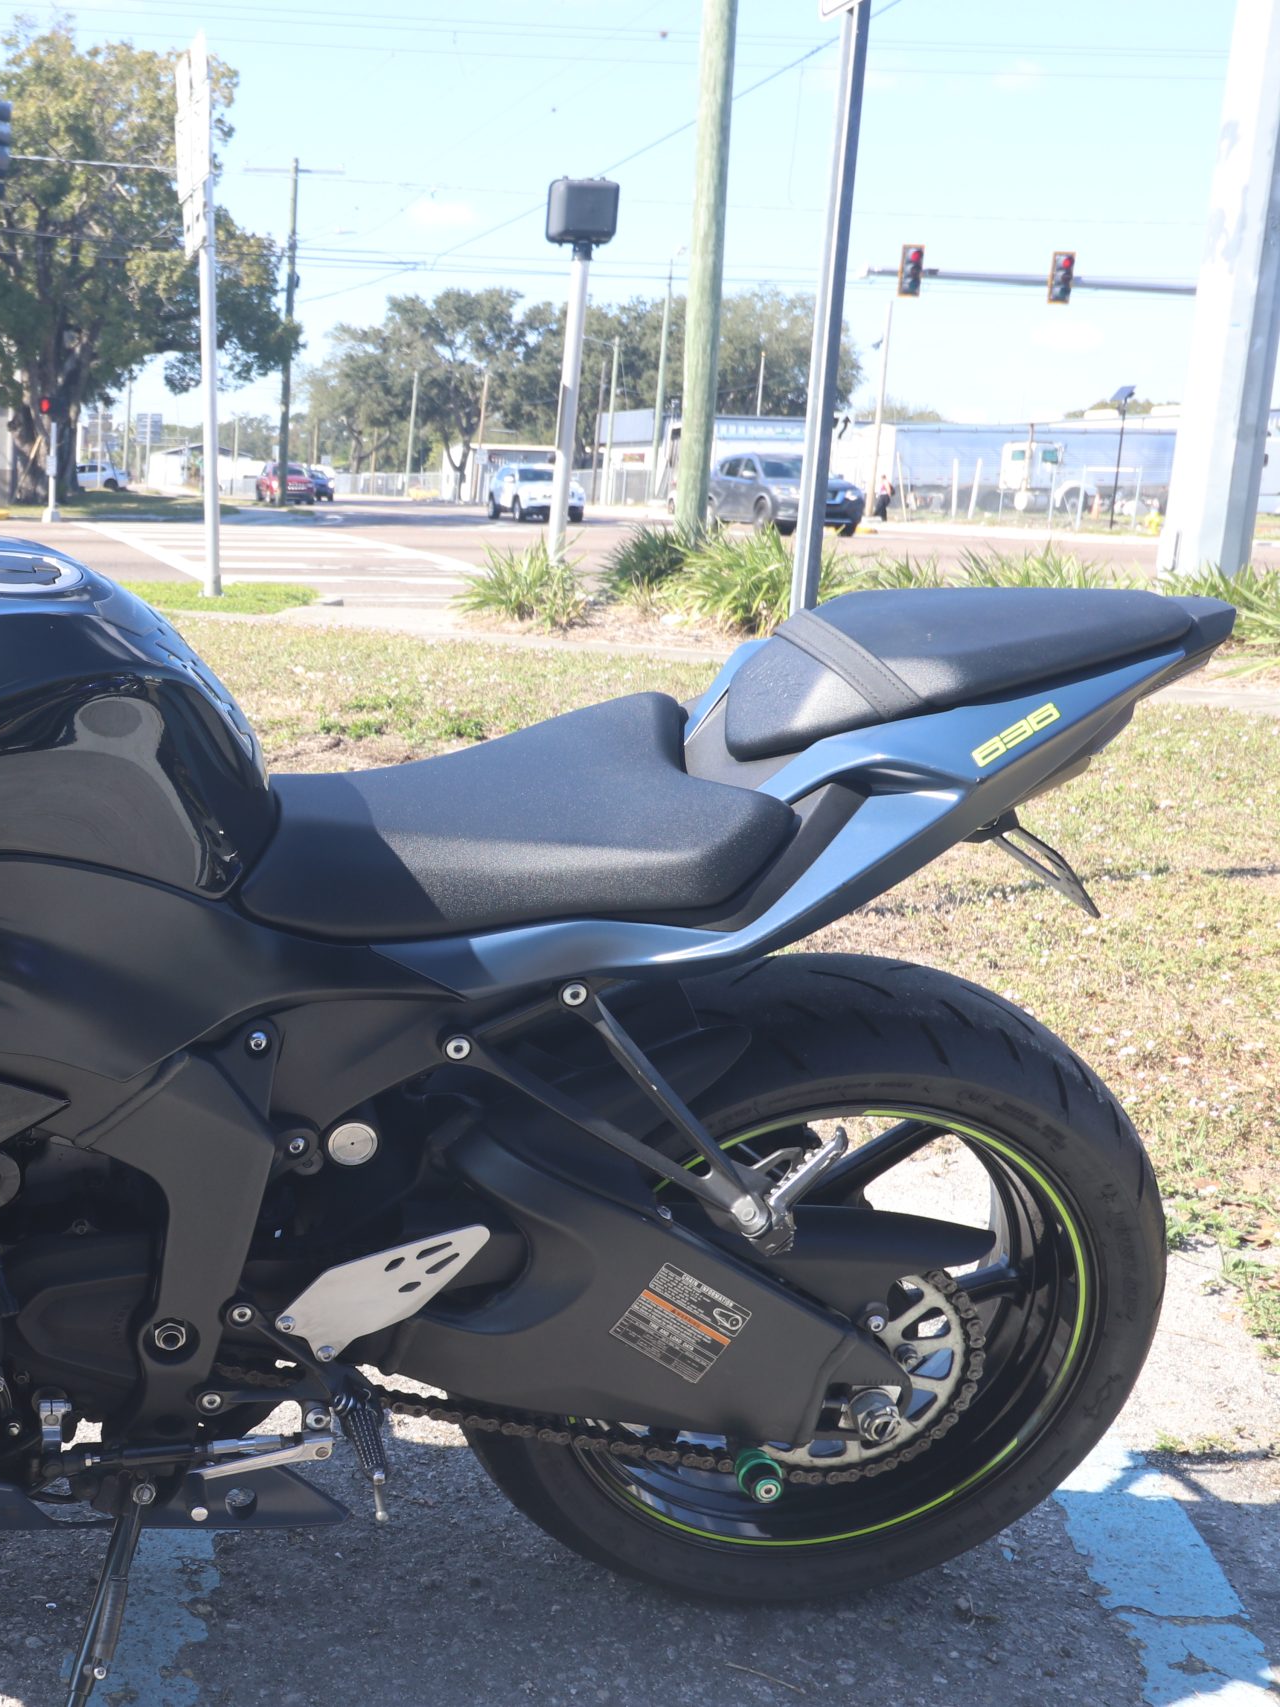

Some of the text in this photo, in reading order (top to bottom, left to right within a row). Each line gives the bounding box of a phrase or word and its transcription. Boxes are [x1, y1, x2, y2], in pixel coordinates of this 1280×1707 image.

[971, 702, 1061, 768] 636
[681, 1274, 734, 1308] CHAIN INFORMATION
[648, 1321, 694, 1352] TIRE AND LOAD DATA
